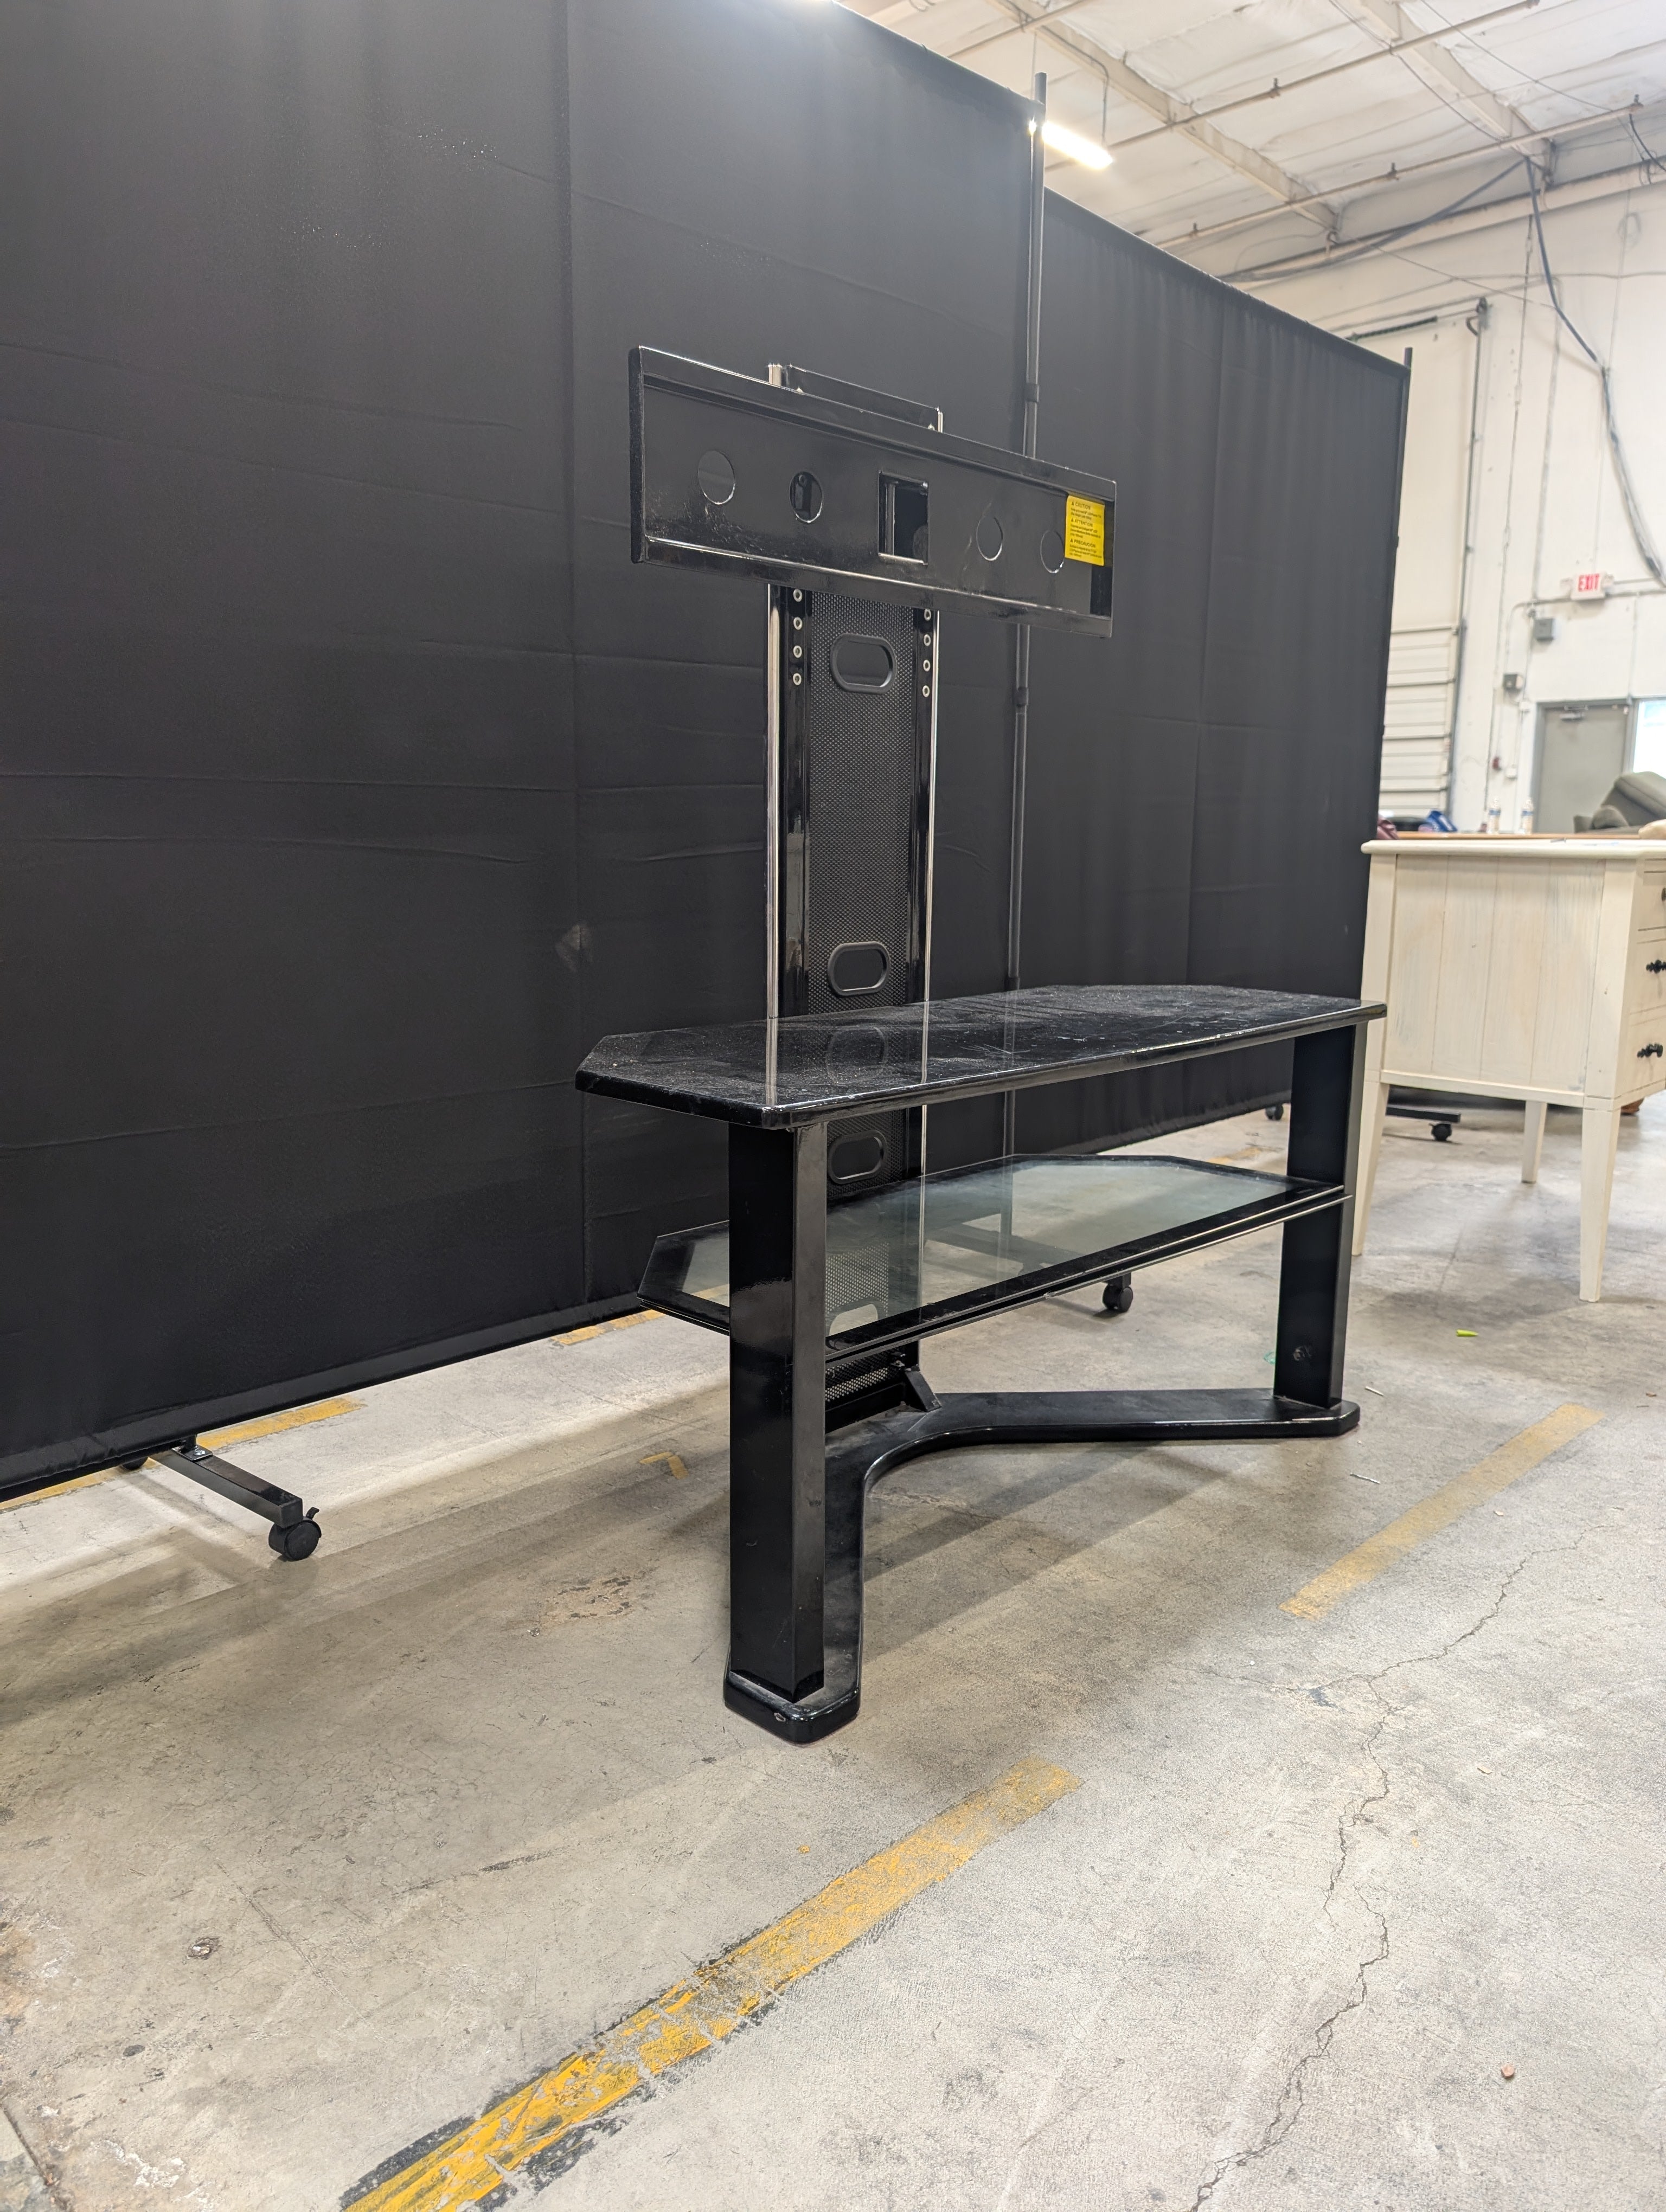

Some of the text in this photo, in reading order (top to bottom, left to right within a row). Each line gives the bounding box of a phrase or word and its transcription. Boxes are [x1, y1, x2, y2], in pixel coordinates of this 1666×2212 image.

[1075, 501, 1091, 510] CAUTION
[1074, 519, 1093, 527] ATTENTION
[1578, 574, 1599, 592] EXIT
